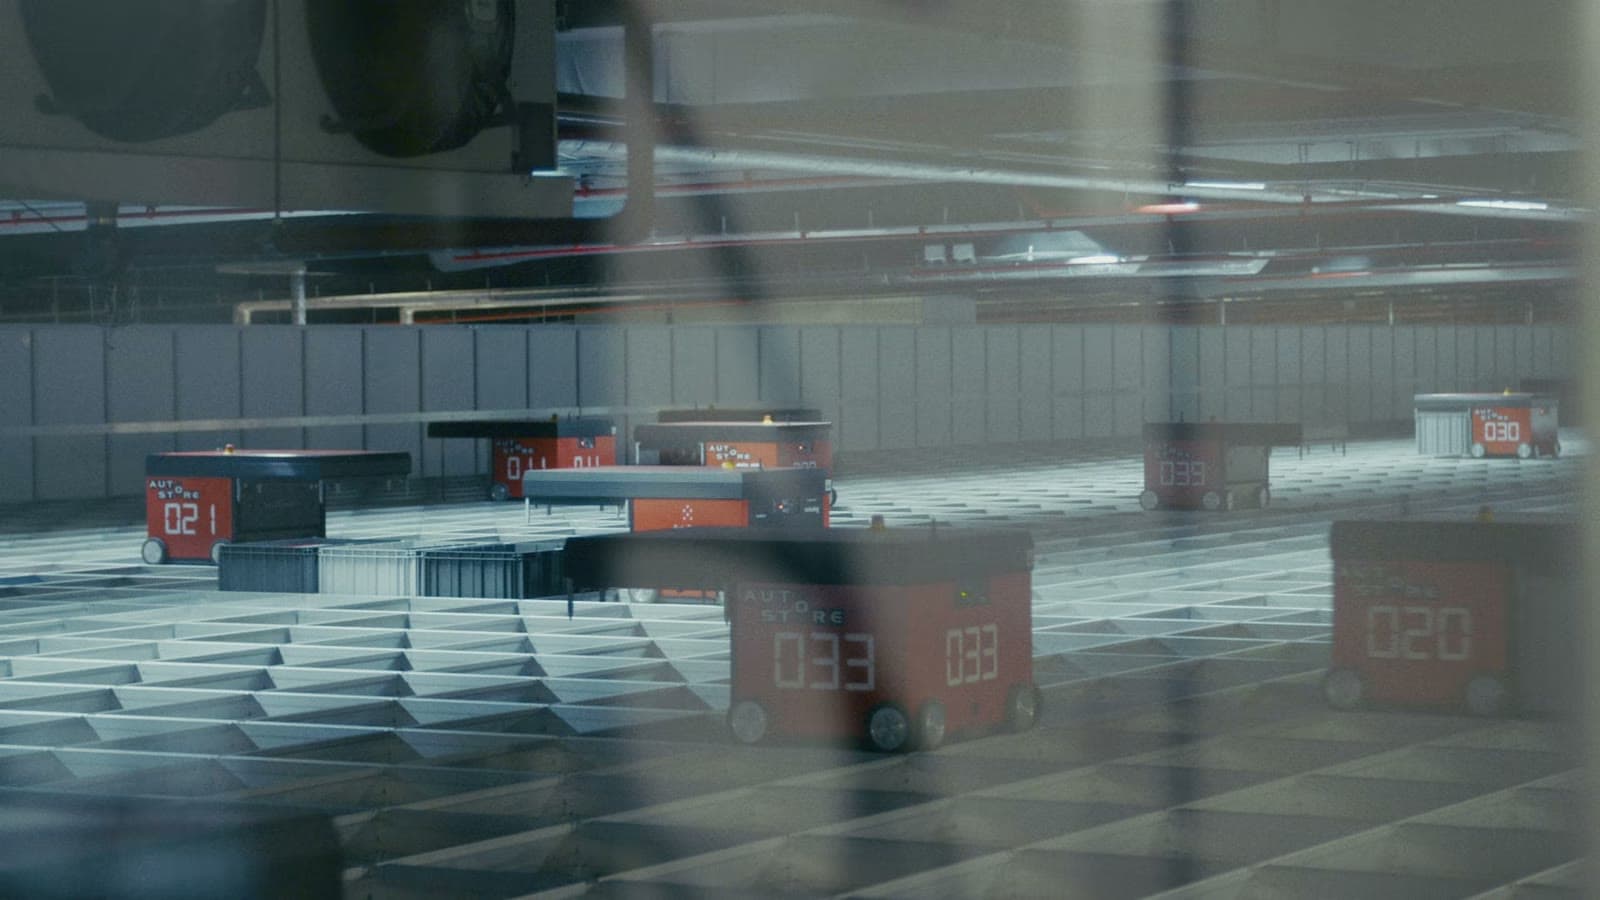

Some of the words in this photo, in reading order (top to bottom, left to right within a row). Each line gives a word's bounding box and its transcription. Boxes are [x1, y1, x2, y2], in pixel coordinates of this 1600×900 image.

[1484, 422, 1520, 441] 030
[164, 503, 216, 535] 021
[774, 631, 876, 691] 033
[946, 623, 998, 686] 033
[1366, 604, 1473, 661] 020
